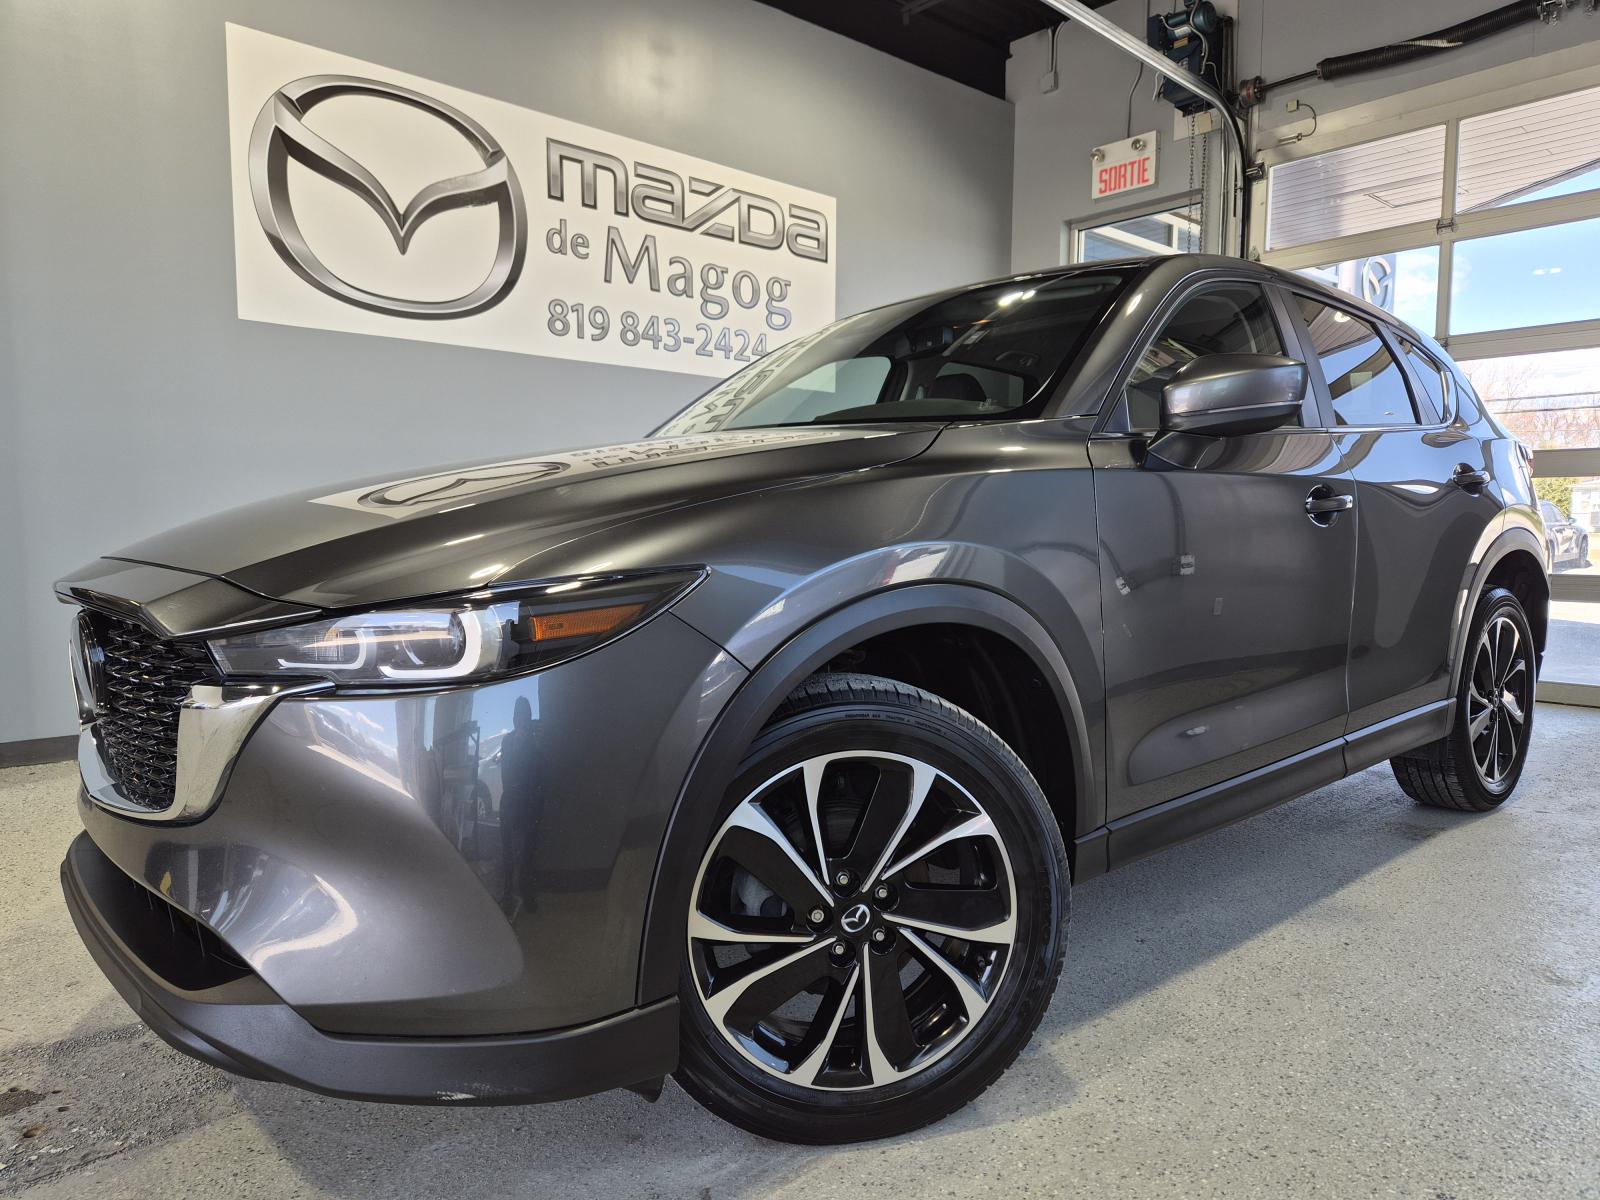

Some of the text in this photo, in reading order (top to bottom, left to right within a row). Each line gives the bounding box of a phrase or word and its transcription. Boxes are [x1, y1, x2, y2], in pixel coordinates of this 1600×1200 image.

[1098, 156, 1151, 195] SORTIE
[546, 218, 793, 331] de Magog
[546, 298, 769, 363] 819 843-2424
